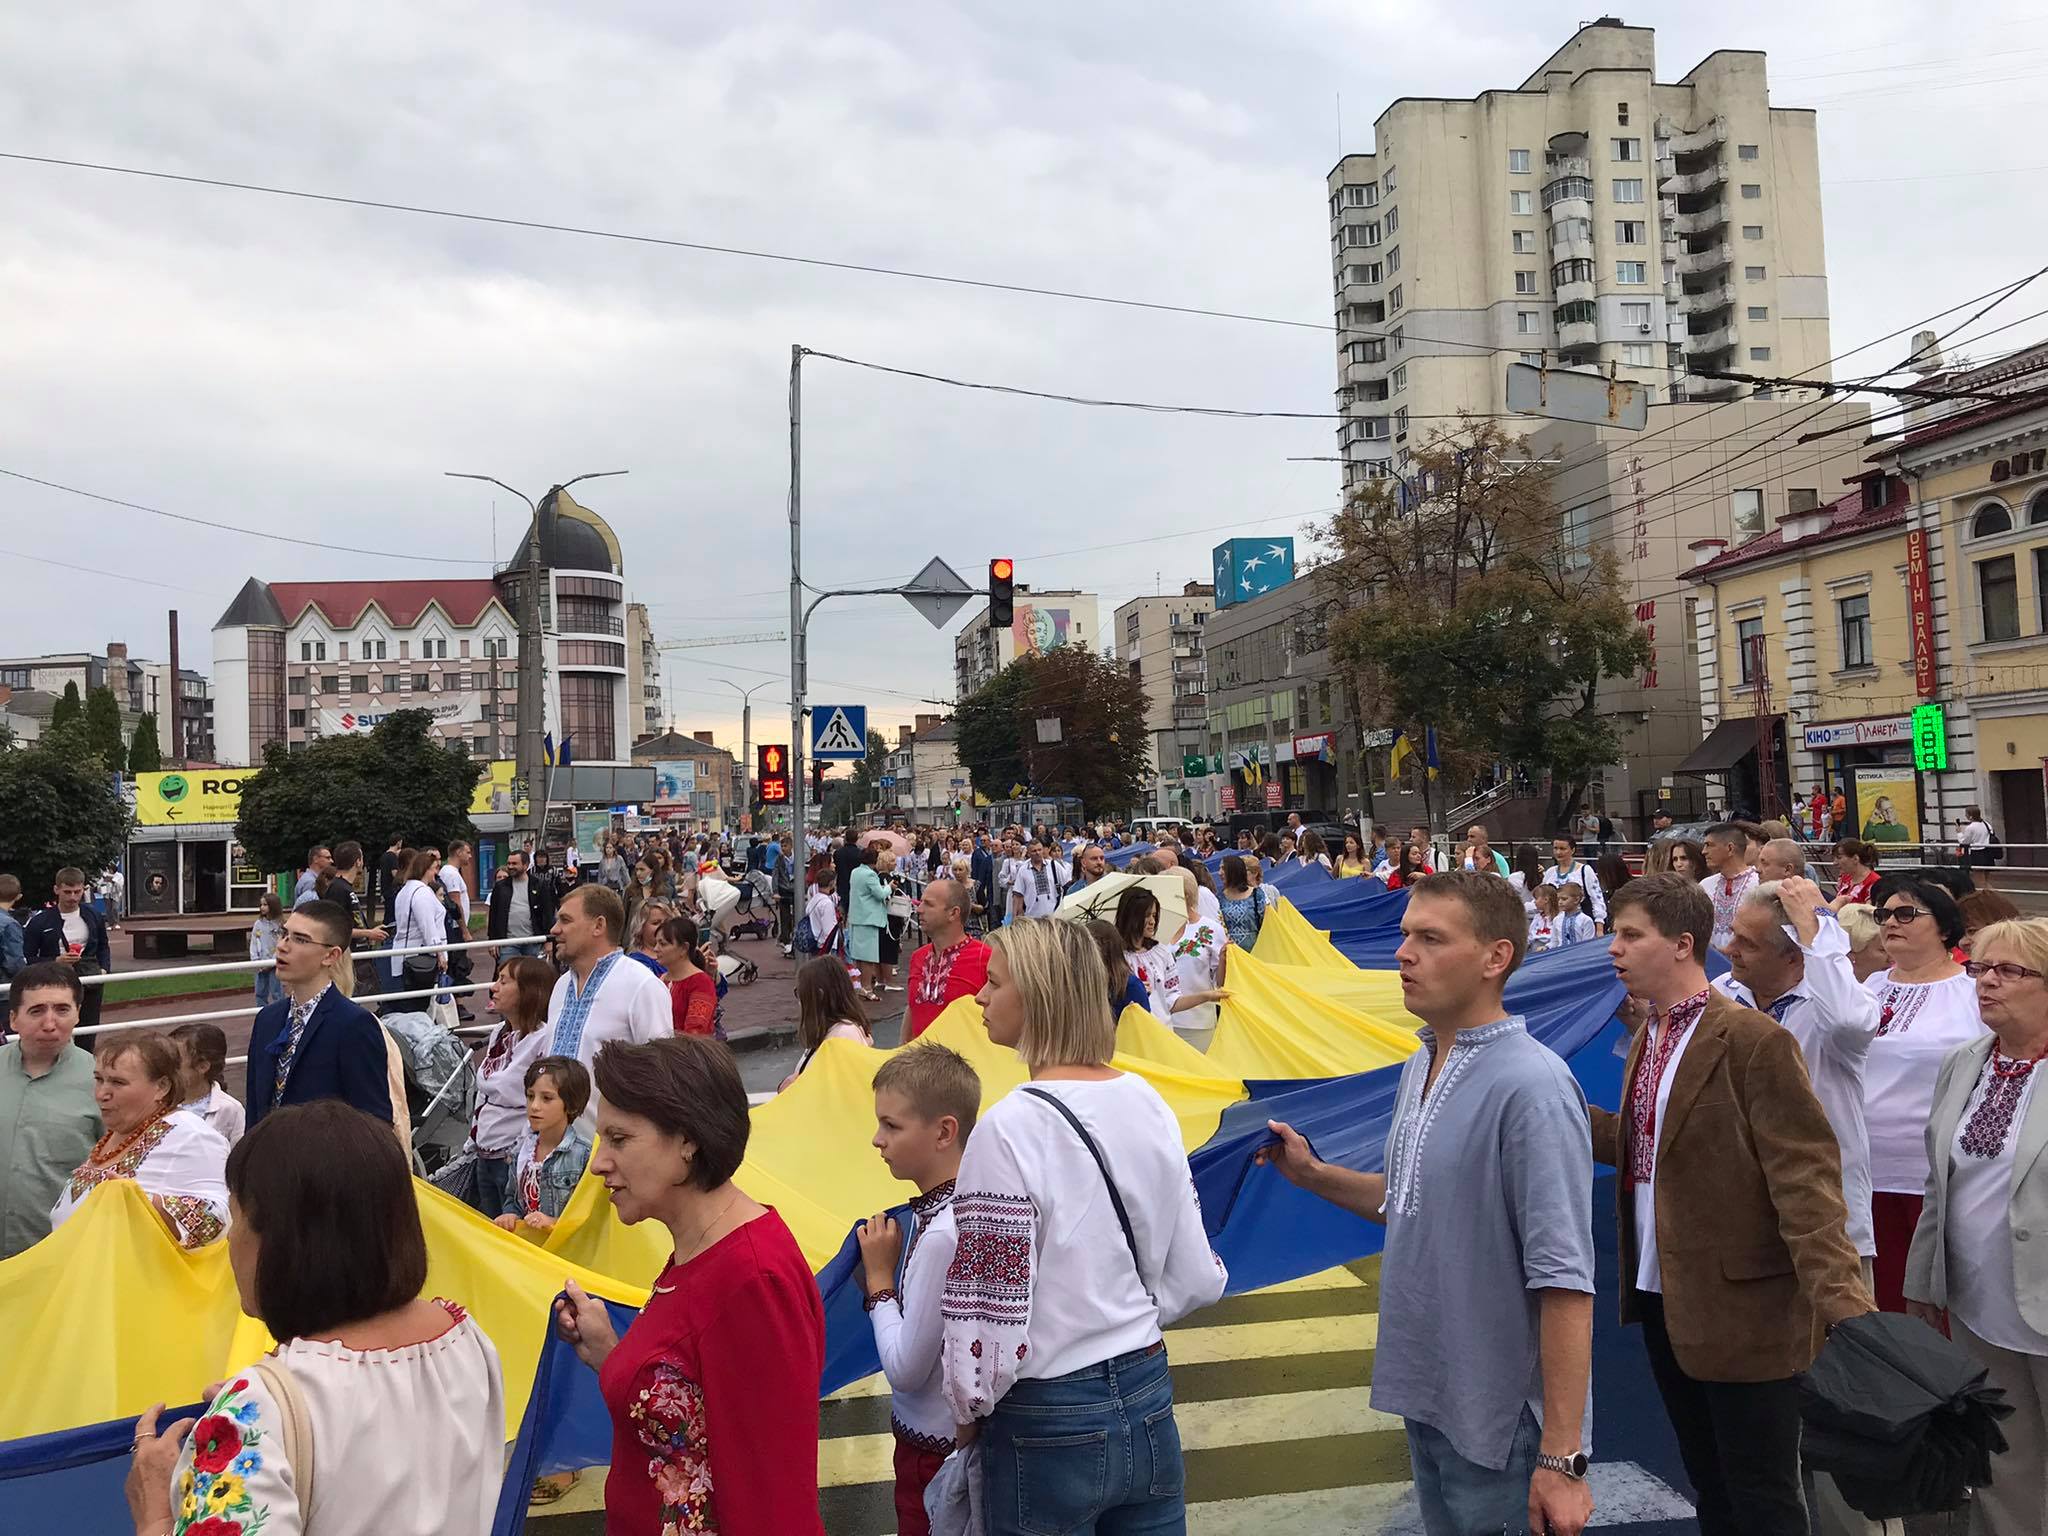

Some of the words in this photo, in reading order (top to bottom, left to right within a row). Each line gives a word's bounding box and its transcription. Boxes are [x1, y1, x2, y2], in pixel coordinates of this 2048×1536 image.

[1910, 532, 1923, 603] ОБМІН
[1915, 613, 1929, 686] ВАЛЮТ
[1806, 728, 1832, 744] КІНО
[764, 780, 785, 799] 35
